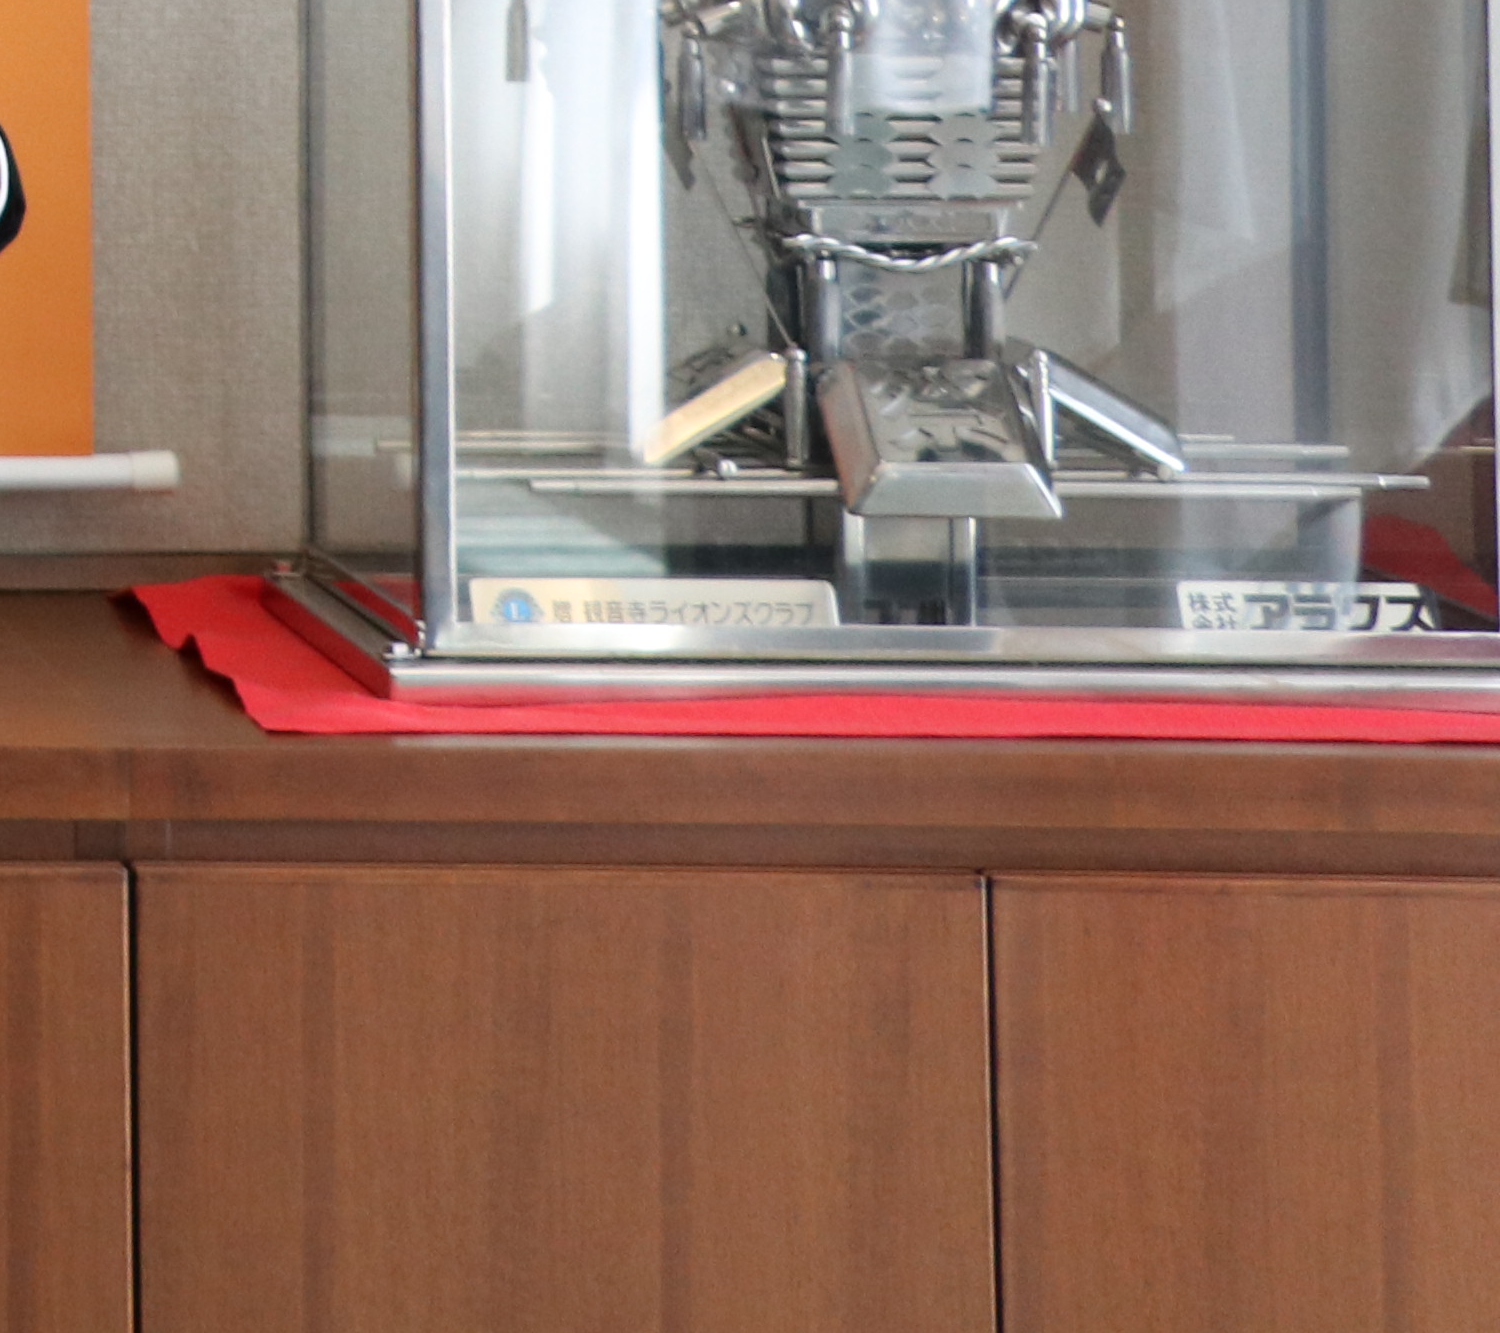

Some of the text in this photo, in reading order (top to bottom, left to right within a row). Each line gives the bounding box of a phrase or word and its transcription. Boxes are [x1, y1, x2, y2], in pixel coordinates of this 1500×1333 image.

[584, 601, 813, 624] 観音寺ライオンズクラブ
[1188, 592, 1236, 614] 株式
